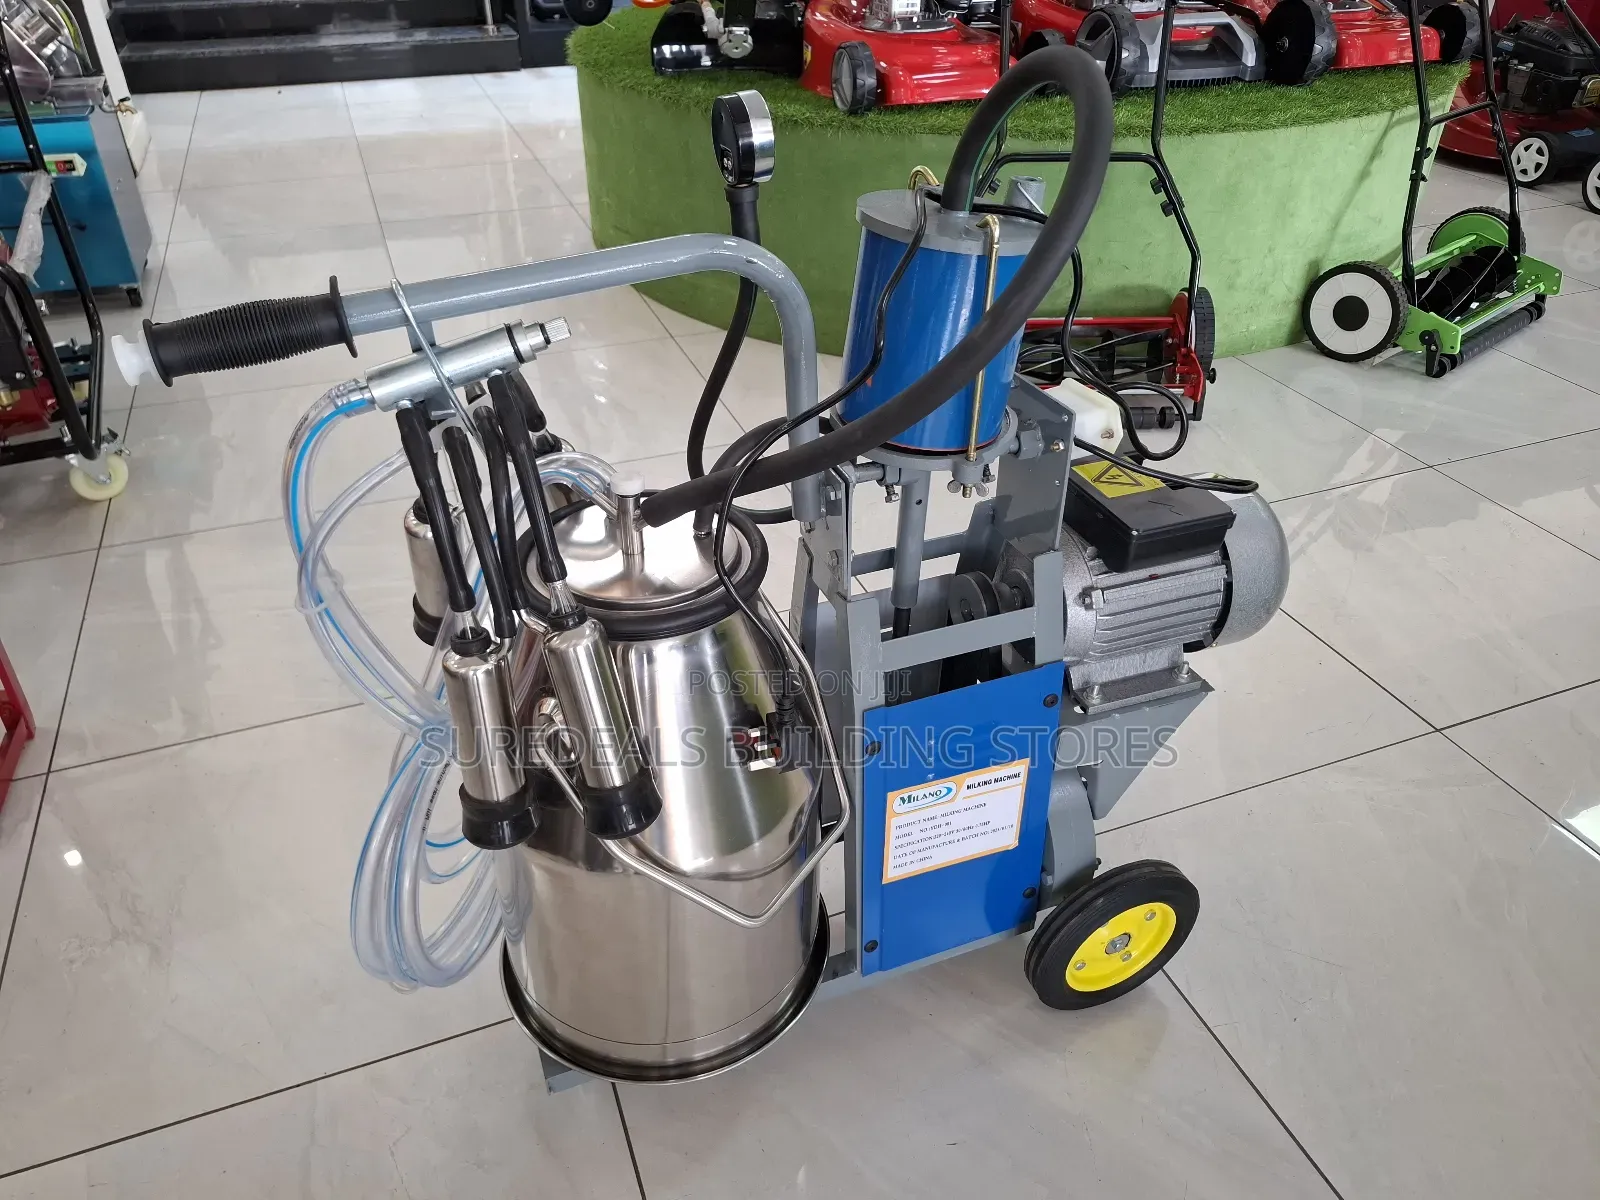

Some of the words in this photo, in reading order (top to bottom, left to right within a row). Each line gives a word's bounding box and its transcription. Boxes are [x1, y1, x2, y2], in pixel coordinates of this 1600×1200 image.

[966, 779, 992, 790] MILKING
[994, 772, 1021, 784] MACHINE
[895, 819, 921, 831] PRODUCT
[963, 802, 987, 812] MACHINE
[894, 831, 914, 841] MODEL
[892, 861, 908, 870] MADE
[915, 855, 933, 864] CHINA
